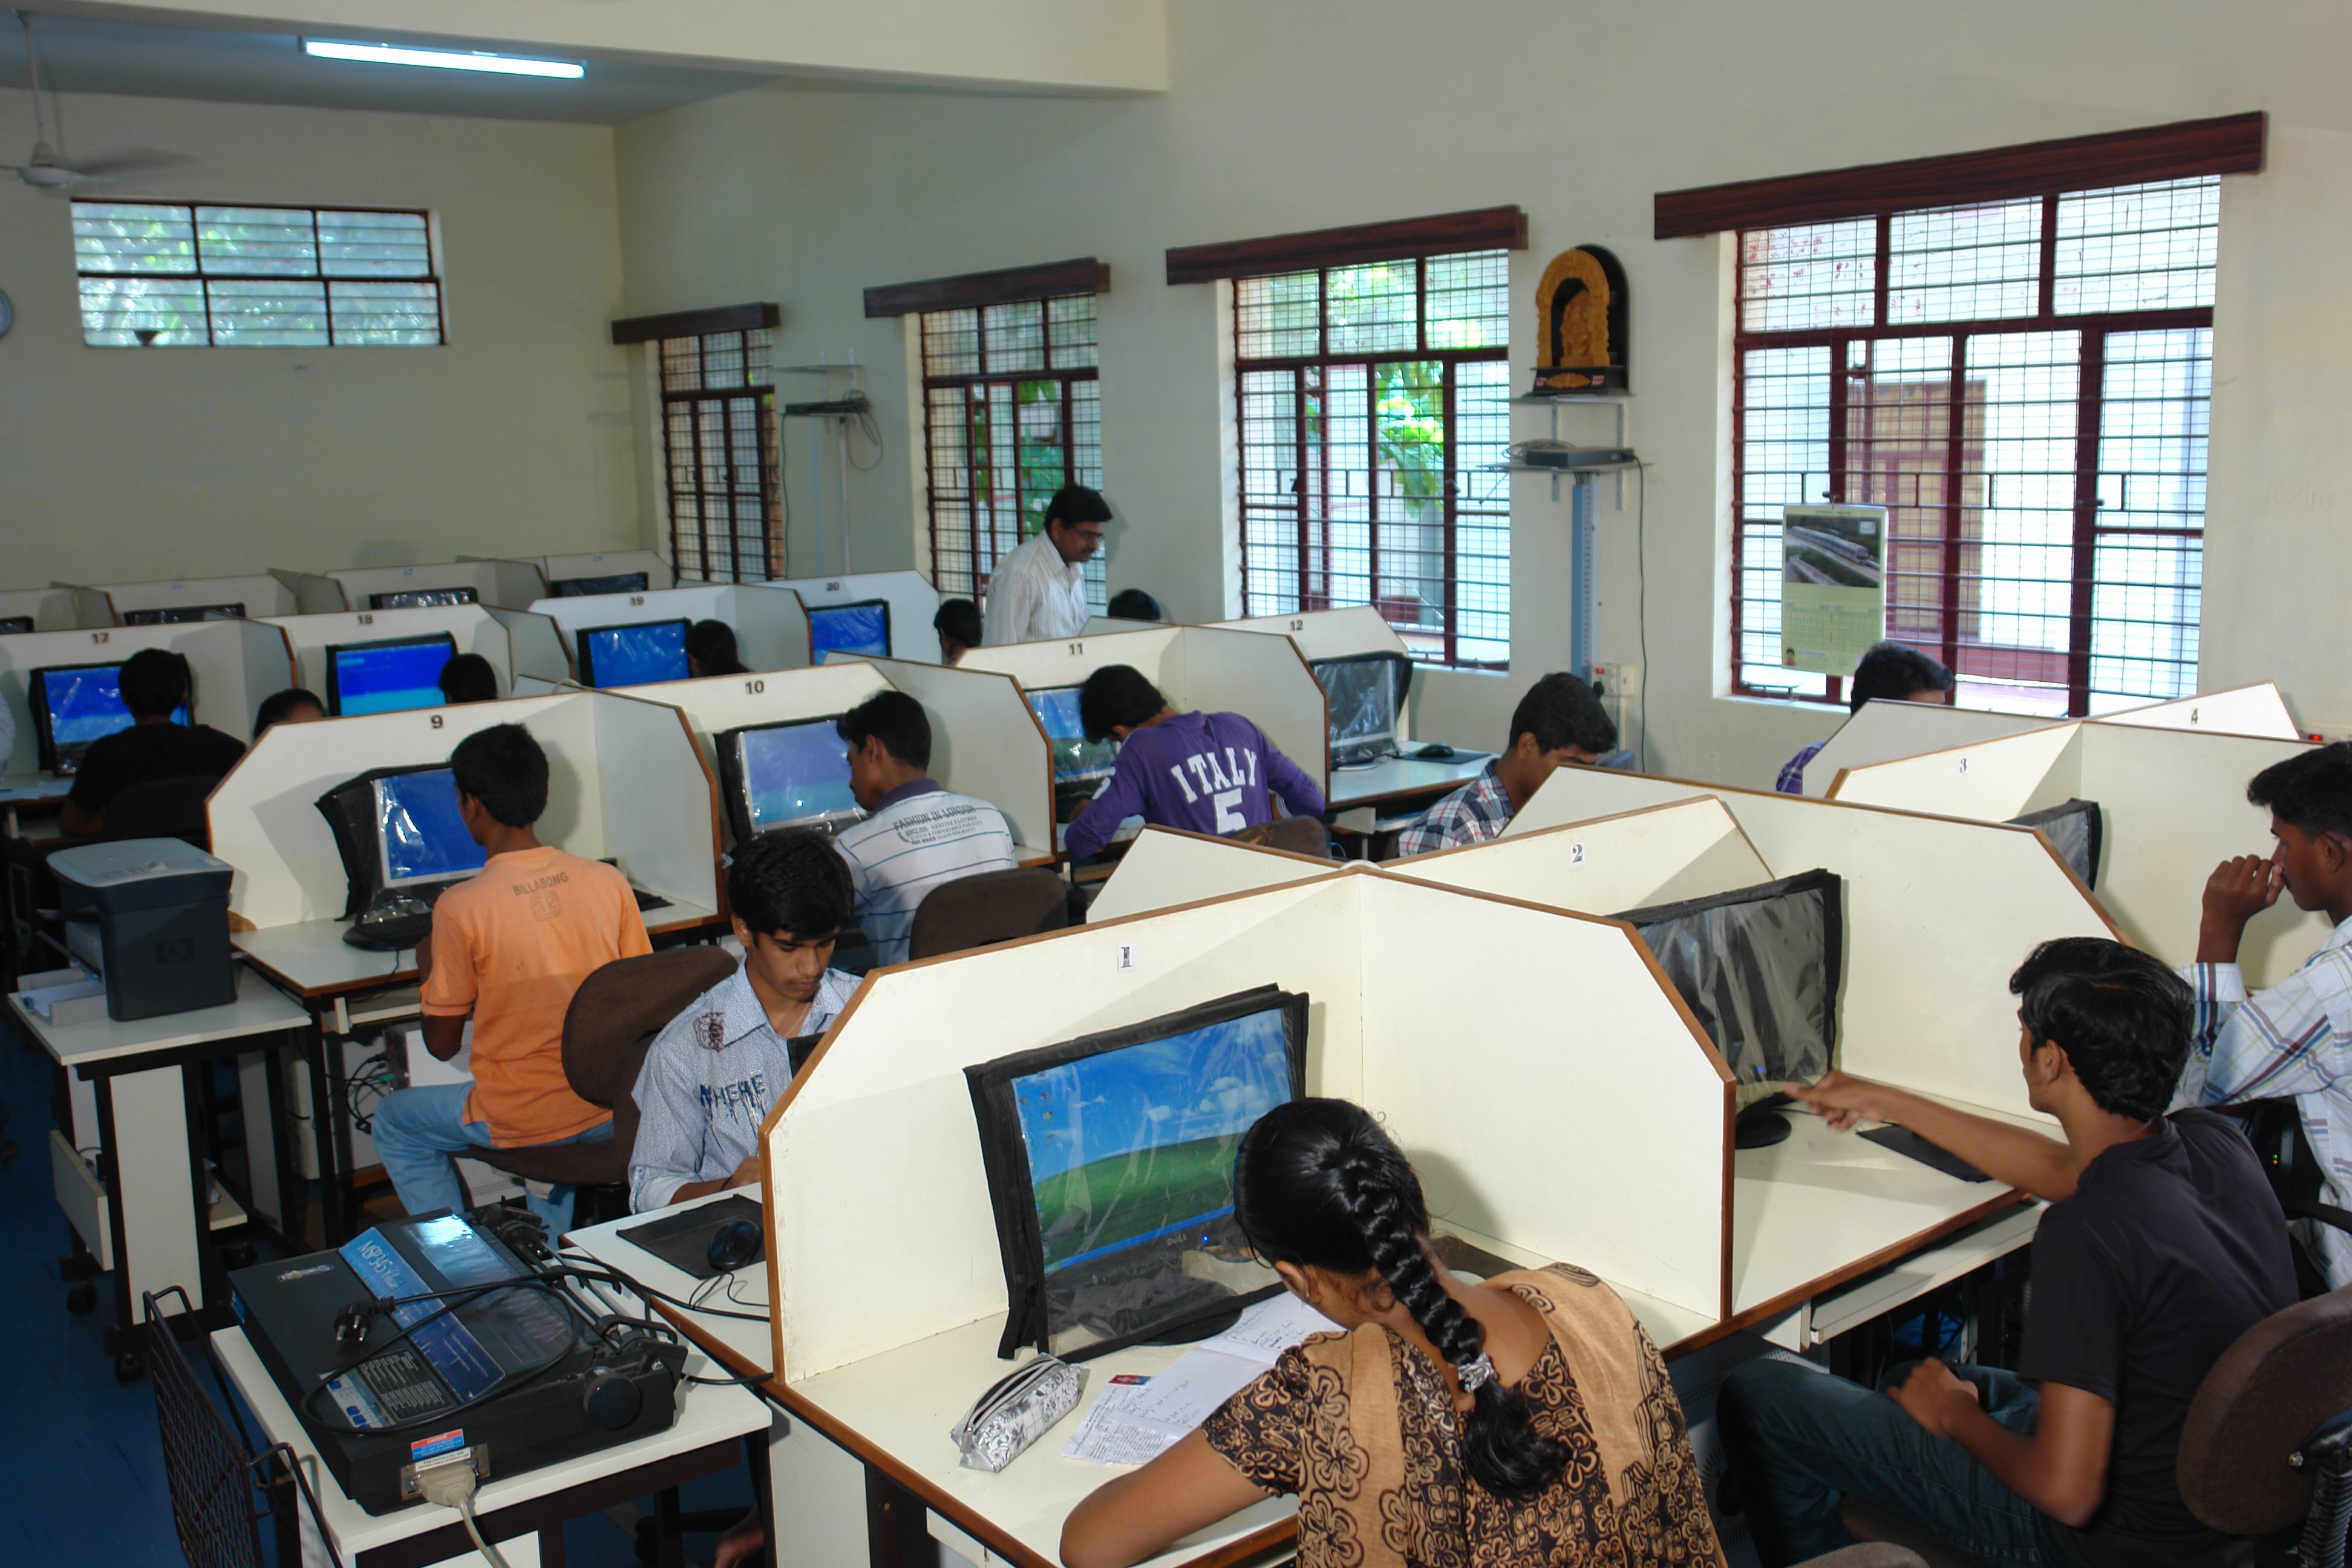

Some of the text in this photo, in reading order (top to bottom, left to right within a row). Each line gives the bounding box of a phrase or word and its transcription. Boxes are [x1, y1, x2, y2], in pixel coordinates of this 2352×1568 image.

[826, 582, 840, 592] 20
[630, 596, 644, 606] 19
[358, 614, 373, 624] 18
[1290, 620, 1304, 631] 12
[92, 632, 109, 643] 17
[1068, 642, 1083, 655] 11
[746, 680, 765, 694] 10
[431, 714, 444, 729] 9
[2191, 708, 2198, 724] 4
[1959, 757, 1967, 774] 3
[1170, 747, 1256, 804] ITALY
[893, 812, 931, 831] FASHION
[930, 810, 942, 821] IN
[942, 803, 977, 817] LONDON
[1214, 788, 1247, 834] 5
[1572, 844, 1583, 864] 2
[512, 871, 569, 896] BILLABONG
[1121, 946, 1132, 969] 1
